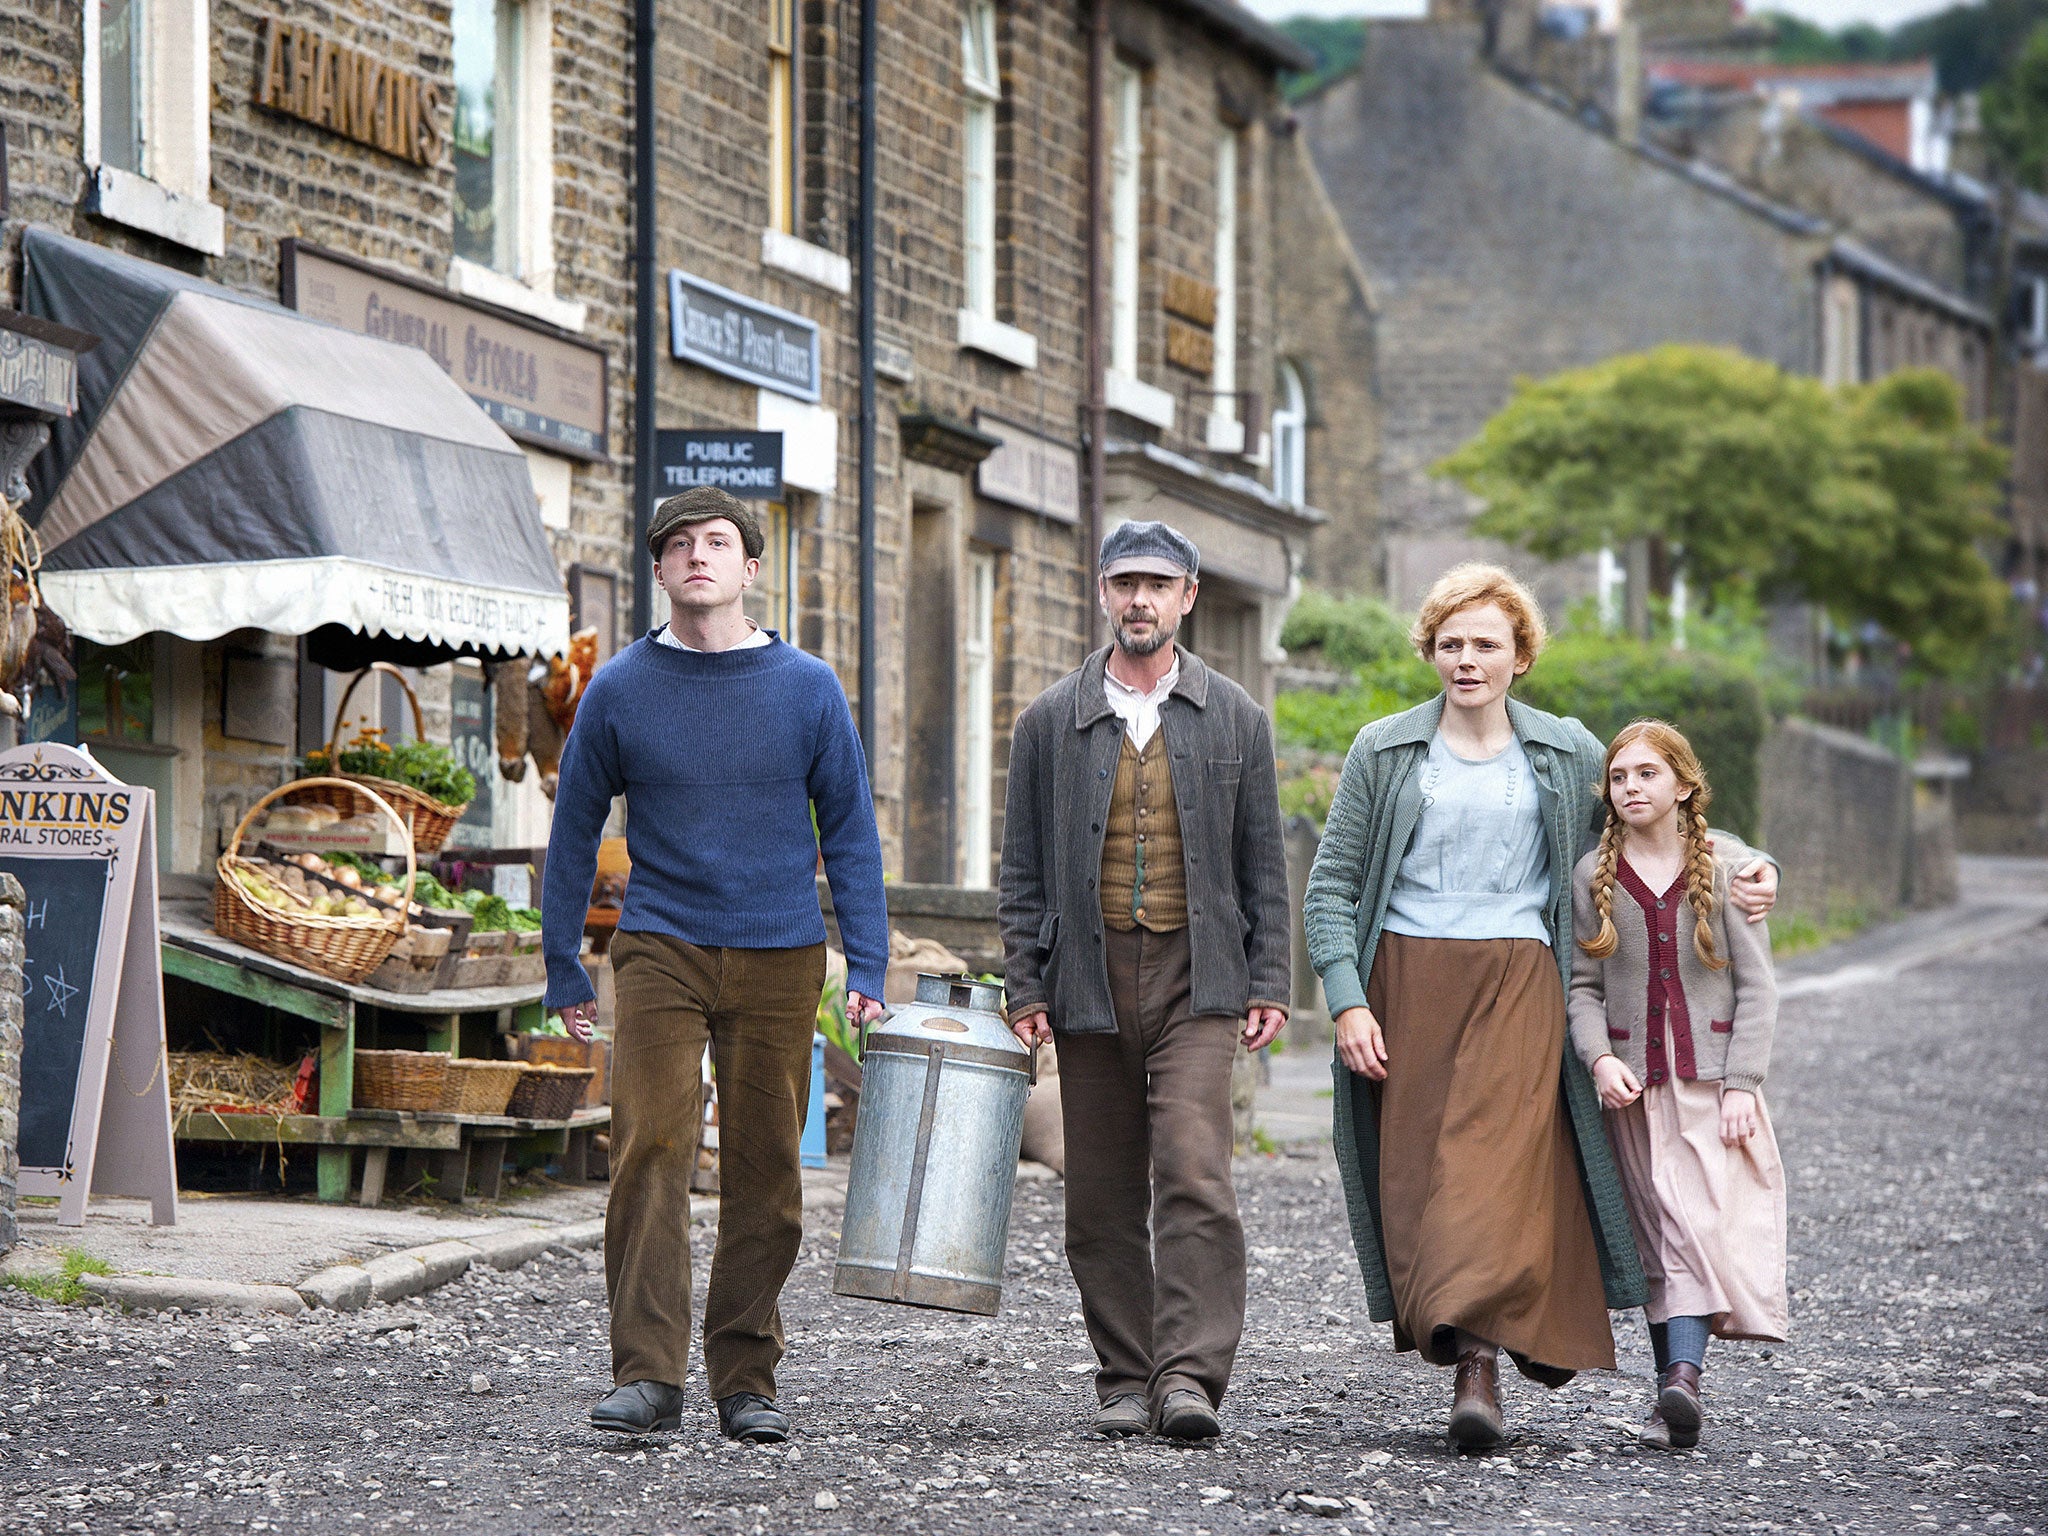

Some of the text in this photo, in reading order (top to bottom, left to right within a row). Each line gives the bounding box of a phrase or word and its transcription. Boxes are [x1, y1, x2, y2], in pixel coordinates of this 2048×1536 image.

[464, 324, 538, 402] STORES
[686, 441, 755, 462] PUBLIC
[664, 466, 777, 487] TELEPHONE
[38, 829, 104, 846] STORES
